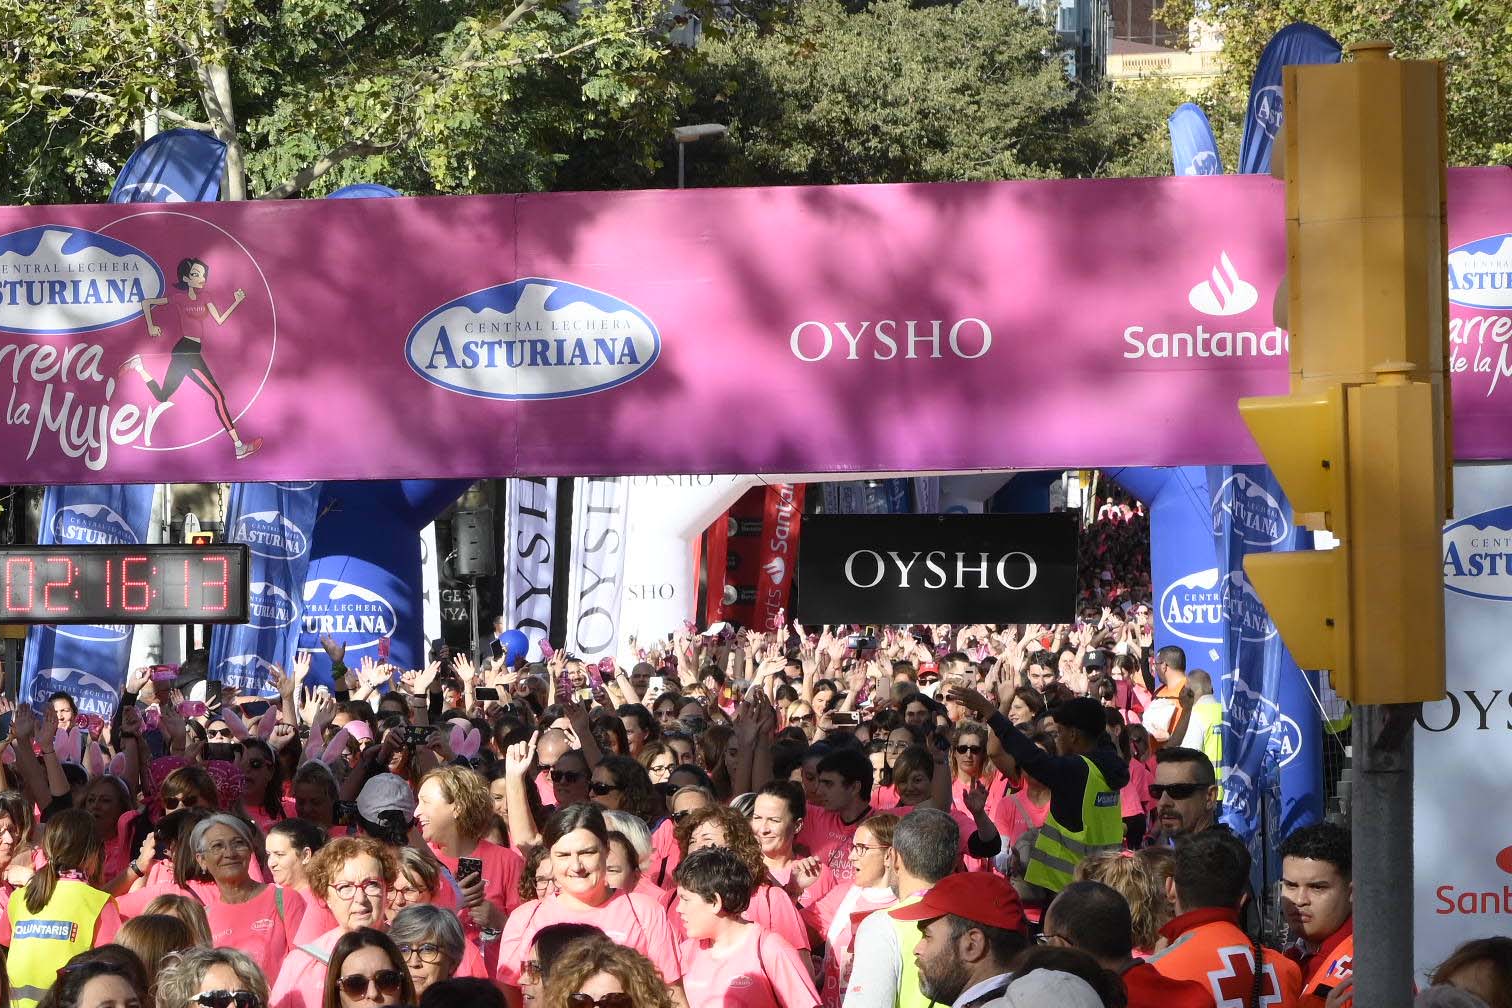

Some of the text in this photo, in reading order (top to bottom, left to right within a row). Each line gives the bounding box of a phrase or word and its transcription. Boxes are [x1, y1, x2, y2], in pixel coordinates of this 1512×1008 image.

[68, 262, 140, 273] LECHERA
[464, 319, 632, 334] CENTRAL LECHERA
[789, 318, 992, 362] OYSHO
[425, 325, 642, 371] ASTURIANA
[1473, 345, 1491, 372] la
[6, 387, 31, 426] la
[25, 376, 175, 471] Mujer
[844, 549, 1038, 591] OYSHO
[334, 604, 383, 613] LECHERA
